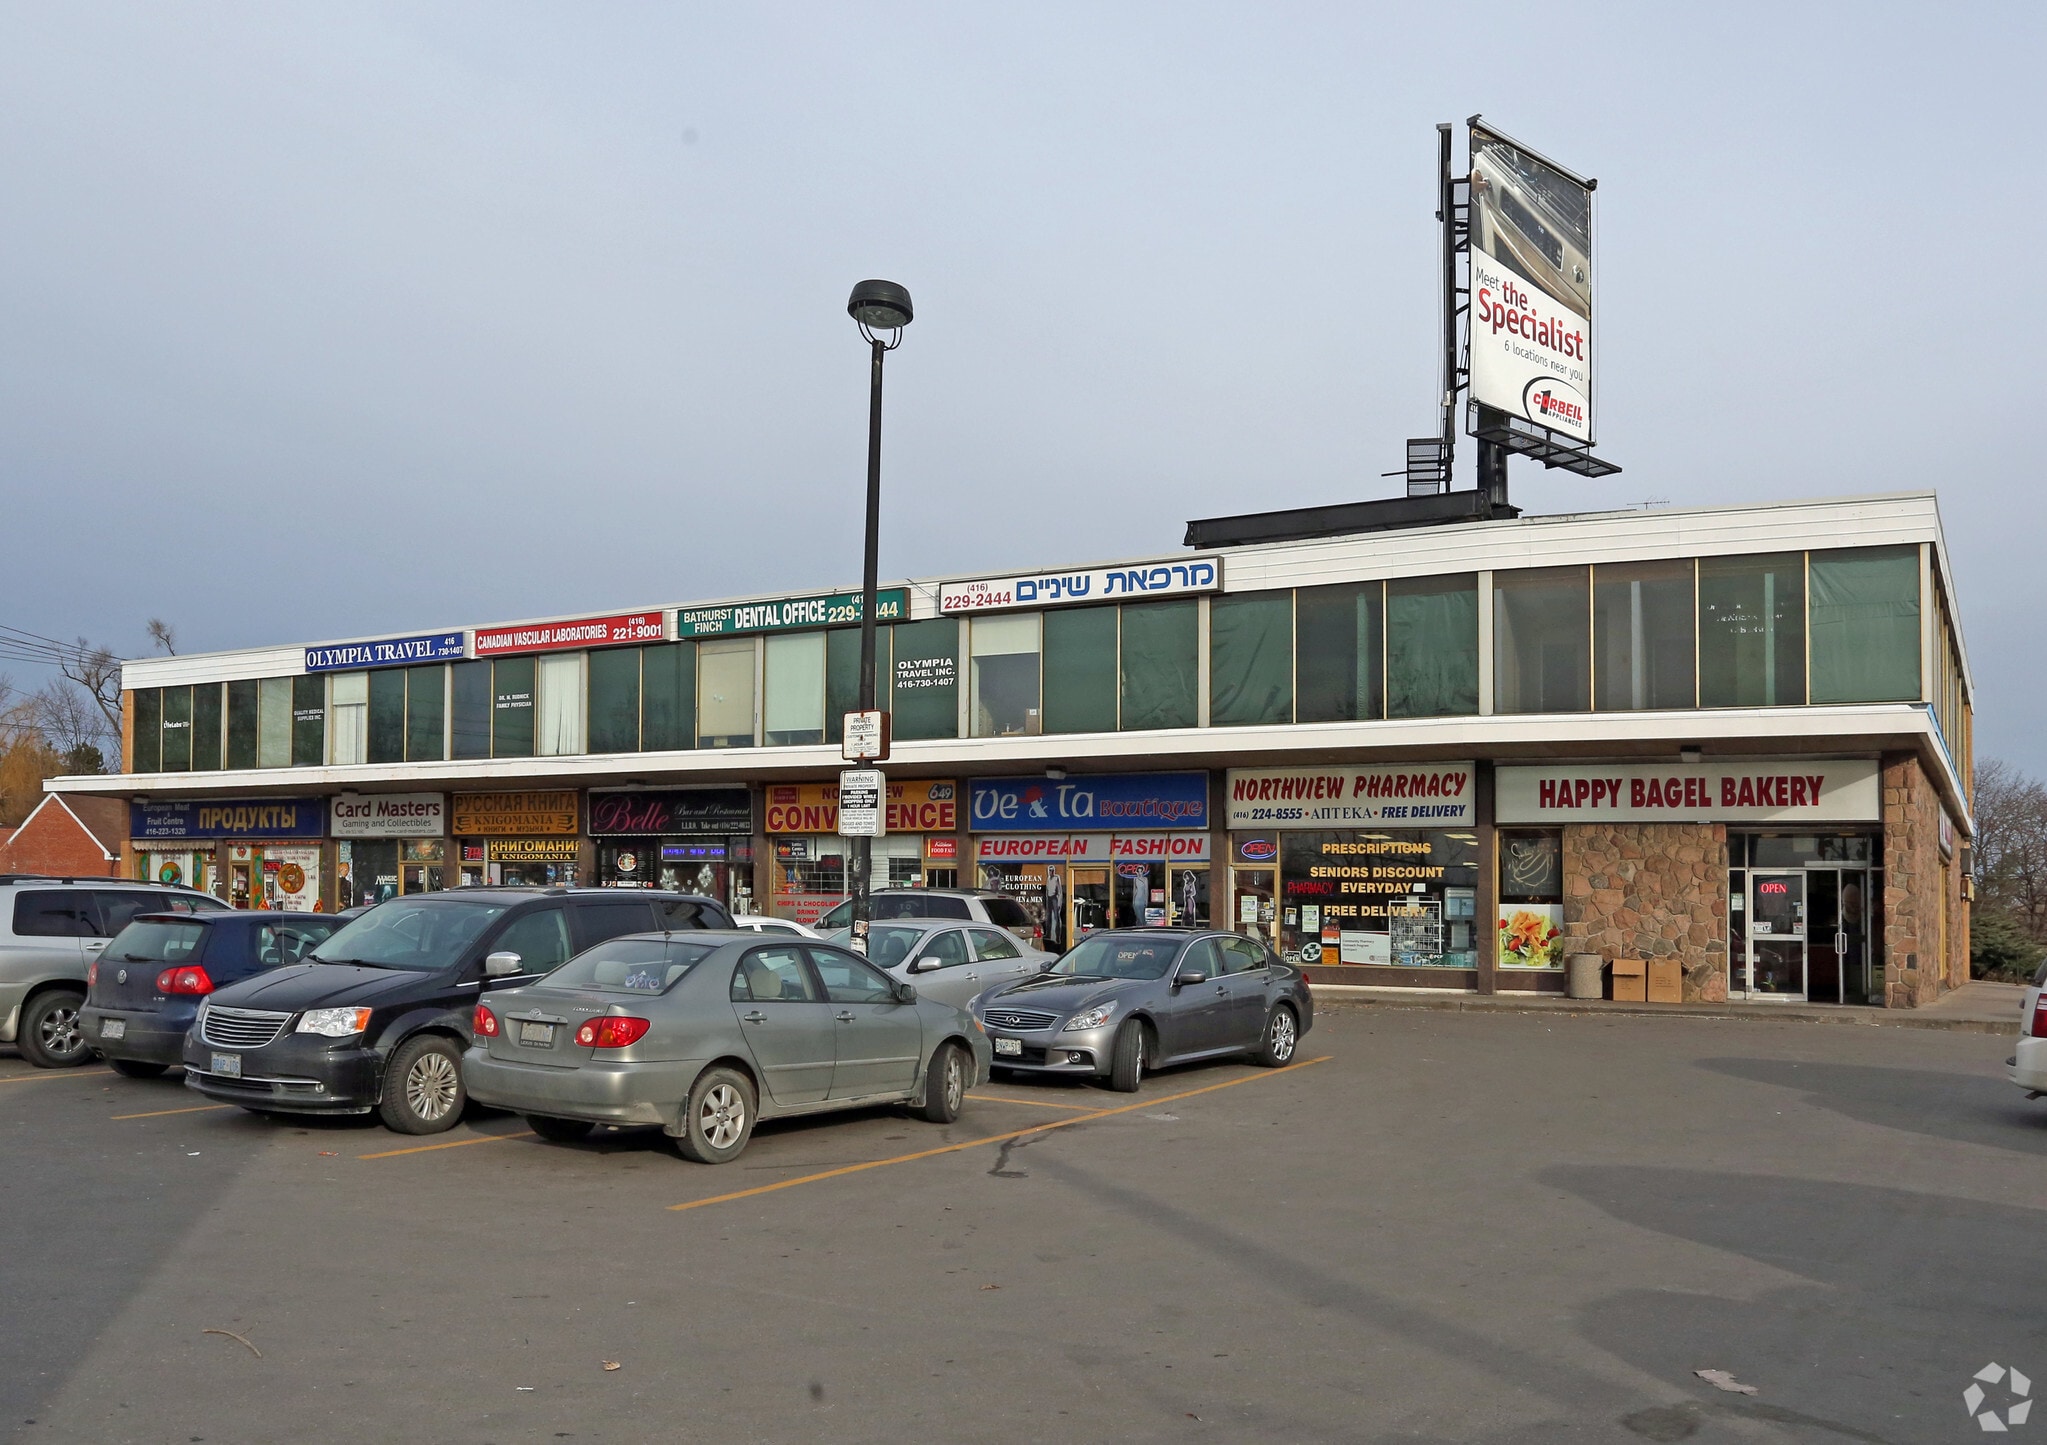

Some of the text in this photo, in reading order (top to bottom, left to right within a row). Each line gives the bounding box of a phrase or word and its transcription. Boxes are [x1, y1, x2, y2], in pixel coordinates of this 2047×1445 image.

[1476, 266, 1528, 311] Meet the
[1478, 288, 1584, 361] Specialist
[1504, 340, 1583, 381] 6 locations near you
[1548, 410, 1582, 428] APPLIANCES
[967, 582, 989, 594] (416)
[1016, 563, 1214, 602] מרפאת שיניים
[944, 591, 1012, 610] 229-2444
[628, 616, 645, 626] (416)
[683, 608, 733, 623] BATHURST
[734, 600, 826, 630] DENTAL OFFICE
[612, 624, 662, 640] 221-9001
[694, 621, 723, 634] FINCH
[444, 637, 455, 645] 416
[477, 624, 608, 650] CANADIAN VASCULAR LABORATORIES
[306, 640, 435, 668] OLYMPIA TRAVEL
[438, 646, 463, 656] 730-1407
[898, 657, 953, 669] OLYMPIA
[896, 667, 956, 679] TRAVEL INC.
[897, 677, 954, 689] 416-730-1407
[853, 716, 872, 724] PRIVATE
[850, 723, 875, 731] PROPERTY
[1233, 772, 1467, 801] NORTHVIEW PHARMACY
[1539, 775, 1825, 809] HAPPY BAGEL BAKERY
[143, 803, 190, 813] European Meat
[456, 792, 575, 812] РУССКАЯ КНИГА
[335, 800, 440, 817] Card Masters
[593, 795, 670, 832] Belle
[693, 806, 709, 815] and
[709, 803, 750, 815] Restaurant
[1233, 804, 1467, 820] (416) 224-8555 АПТЕКА FREE DELIVERY
[162, 817, 184, 825] Centre
[199, 805, 296, 831] ПРОДУКТЫ
[475, 815, 553, 825] KNIGOMANIA
[768, 803, 955, 831] CONVENCE
[342, 820, 369, 829] Gaming
[387, 819, 431, 827] Collectibles
[490, 841, 579, 852] КНИГОМАНИЯ
[980, 838, 1203, 855] EUROPEAN FASHION
[1243, 842, 1276, 854] OPEN
[1322, 843, 1431, 854] PRESCRIPTIONS
[1005, 874, 1042, 882] EUROPEAN
[1310, 867, 1444, 878] SENIORS DISCOUNT
[1287, 882, 1334, 894] PHARMACY
[1340, 882, 1412, 893] EVERYDAY
[1761, 883, 1787, 893] OPEN
[1324, 905, 1428, 917] FREE DELIVERY
